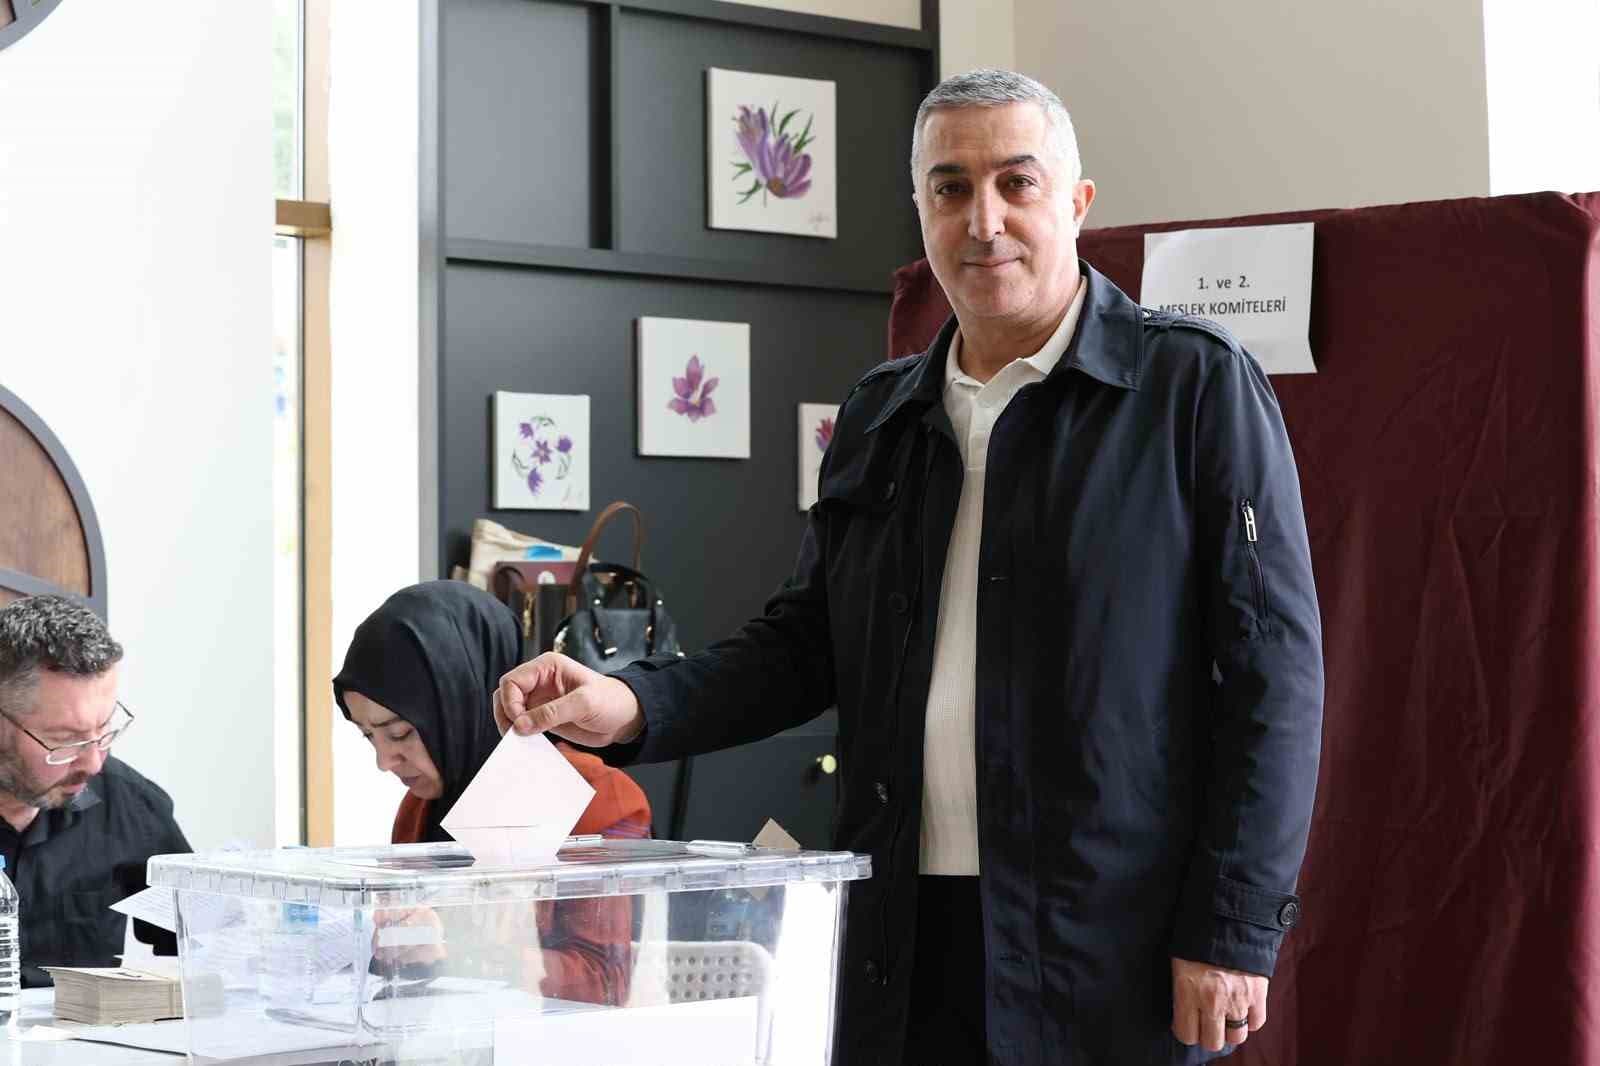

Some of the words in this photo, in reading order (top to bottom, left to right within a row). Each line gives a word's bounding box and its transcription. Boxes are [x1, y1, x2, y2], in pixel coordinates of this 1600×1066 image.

[1197, 276, 1209, 290] 1.
[1216, 279, 1232, 289] ve
[1238, 275, 1251, 288] 2.
[1208, 296, 1287, 315] KOMİTELERİ
